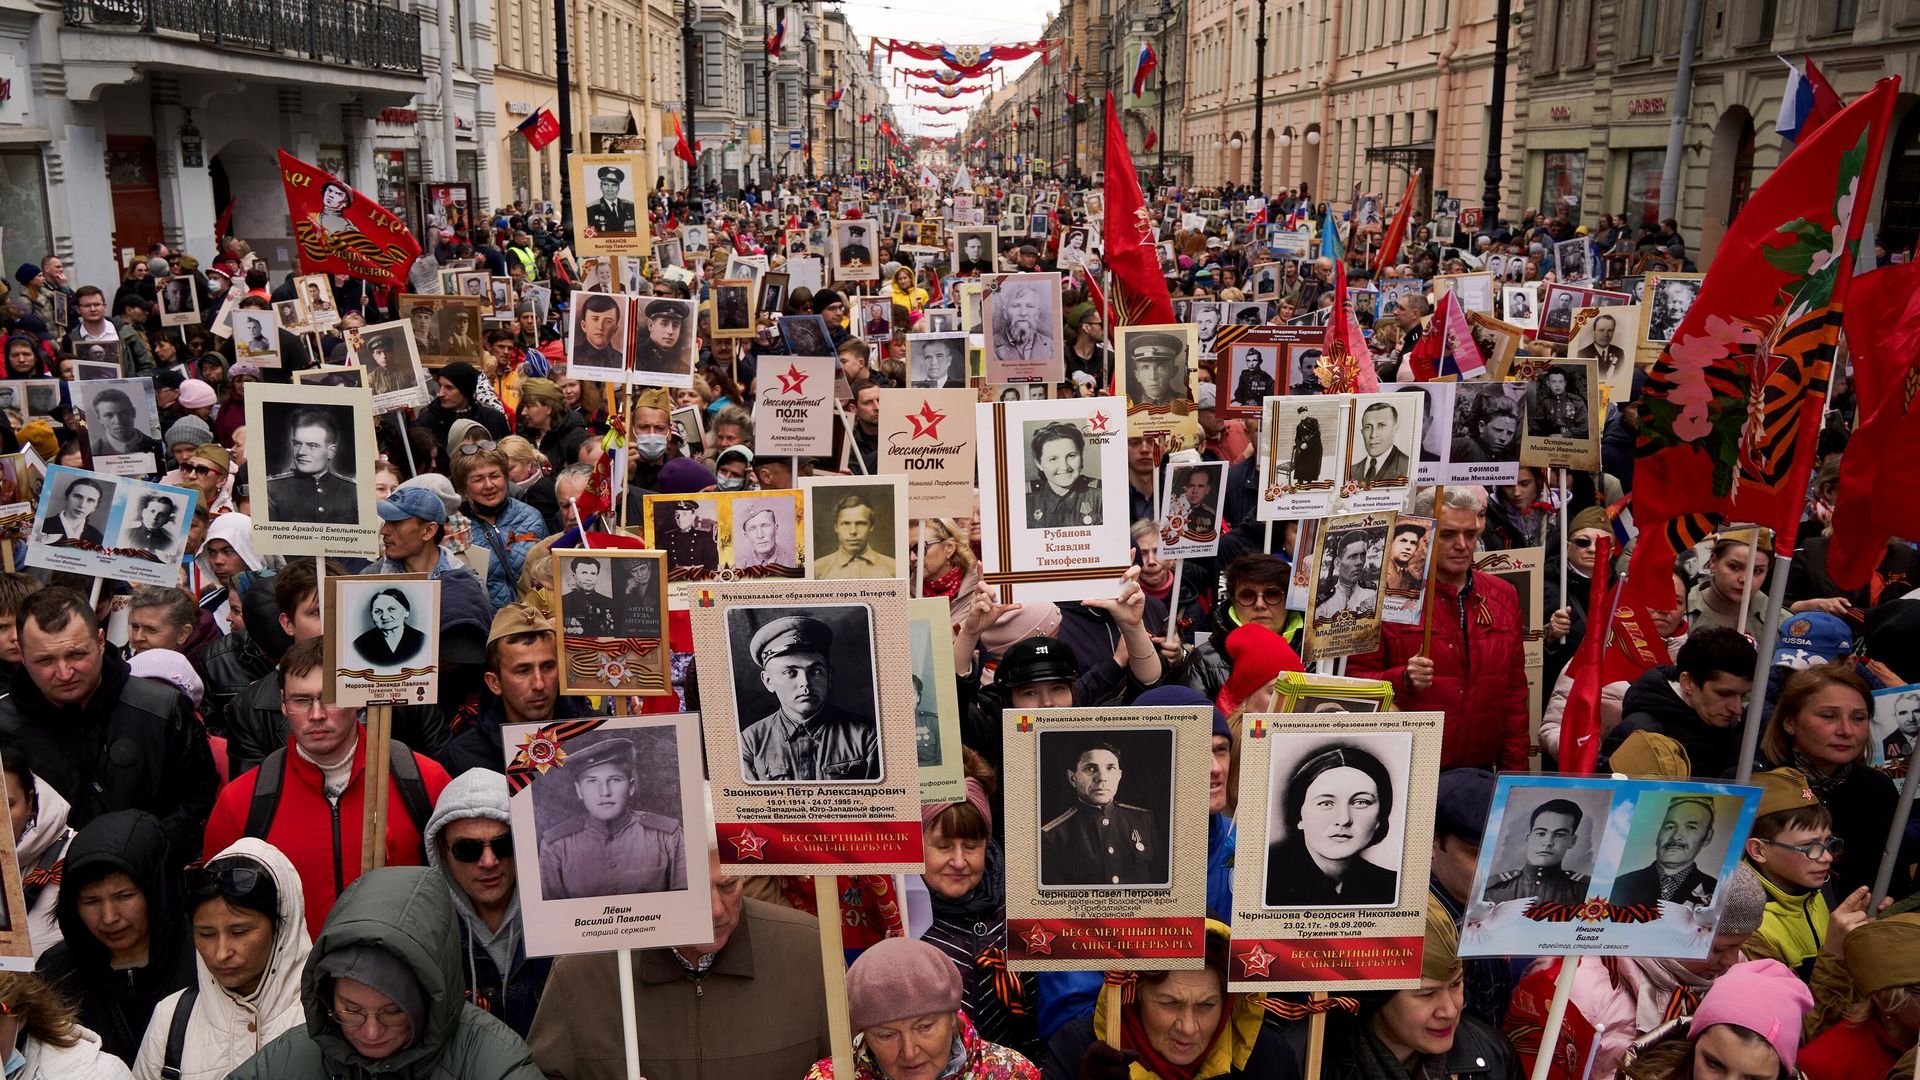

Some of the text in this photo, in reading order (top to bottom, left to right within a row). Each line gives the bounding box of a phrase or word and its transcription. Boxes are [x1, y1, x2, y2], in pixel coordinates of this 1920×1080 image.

[775, 408, 808, 418] ПОЛК
[770, 434, 816, 442] Александрович
[1557, 446, 1589, 454] Иванович
[904, 458, 945, 470] ПОЛК
[253, 523, 376, 535] Савельев Аркадий Емельянович
[320, 535, 359, 543] политрук
[1043, 529, 1092, 540] Рубанова
[1045, 543, 1091, 553] Клавдия
[1036, 556, 1101, 567] Тимофеевна
[722, 593, 783, 601] Муниципальное
[785, 592, 834, 600] образование
[860, 590, 897, 598] Петергоф
[1330, 620, 1356, 629] МАСЛОВ
[1315, 623, 1373, 638] ВЛАДИМИР ИЛЬИЧ
[1095, 715, 1140, 723] образование
[1164, 713, 1199, 721] Петергоф
[1272, 721, 1330, 729] Муниципальное
[1332, 720, 1378, 728] образование
[1402, 720, 1436, 728] Петергоф
[723, 787, 906, 799] Звонкович Пётр Александрович
[736, 805, 896, 814] Северо-Западный, Юго-Западный фронт.
[808, 812, 867, 820] Отечественной
[782, 832, 909, 843] БЕССМЕРТНЫЙ ПОЛК
[793, 843, 902, 852] САНКТ-ПЕТЕРБУРГА
[1038, 889, 1171, 900] Чернышов Павел Петрович
[1030, 898, 1067, 906] Старший
[1154, 897, 1178, 905] фронт
[603, 905, 632, 915] Лёвин
[1080, 904, 1141, 912] Прибалтийский
[1238, 910, 1420, 920] Чернышова Феодосия Николаевна
[574, 913, 662, 928] Василий Павлович
[1329, 921, 1377, 929] 09.09.2000г.
[582, 925, 656, 937] старший сержант
[1062, 926, 1194, 937] БЕССМЕРТНЫЙ ПОЛК
[1297, 930, 1338, 938] Труженик
[1071, 941, 1193, 950] САНКТ-ПЕТЕРБУРГА
[1537, 942, 1572, 951] ефрейтор,
[1291, 948, 1414, 959] БЕССМЕРТНЫЙ ПОЛК
[1301, 959, 1405, 968] САНКТ-ПЕТЕРБУРГА
